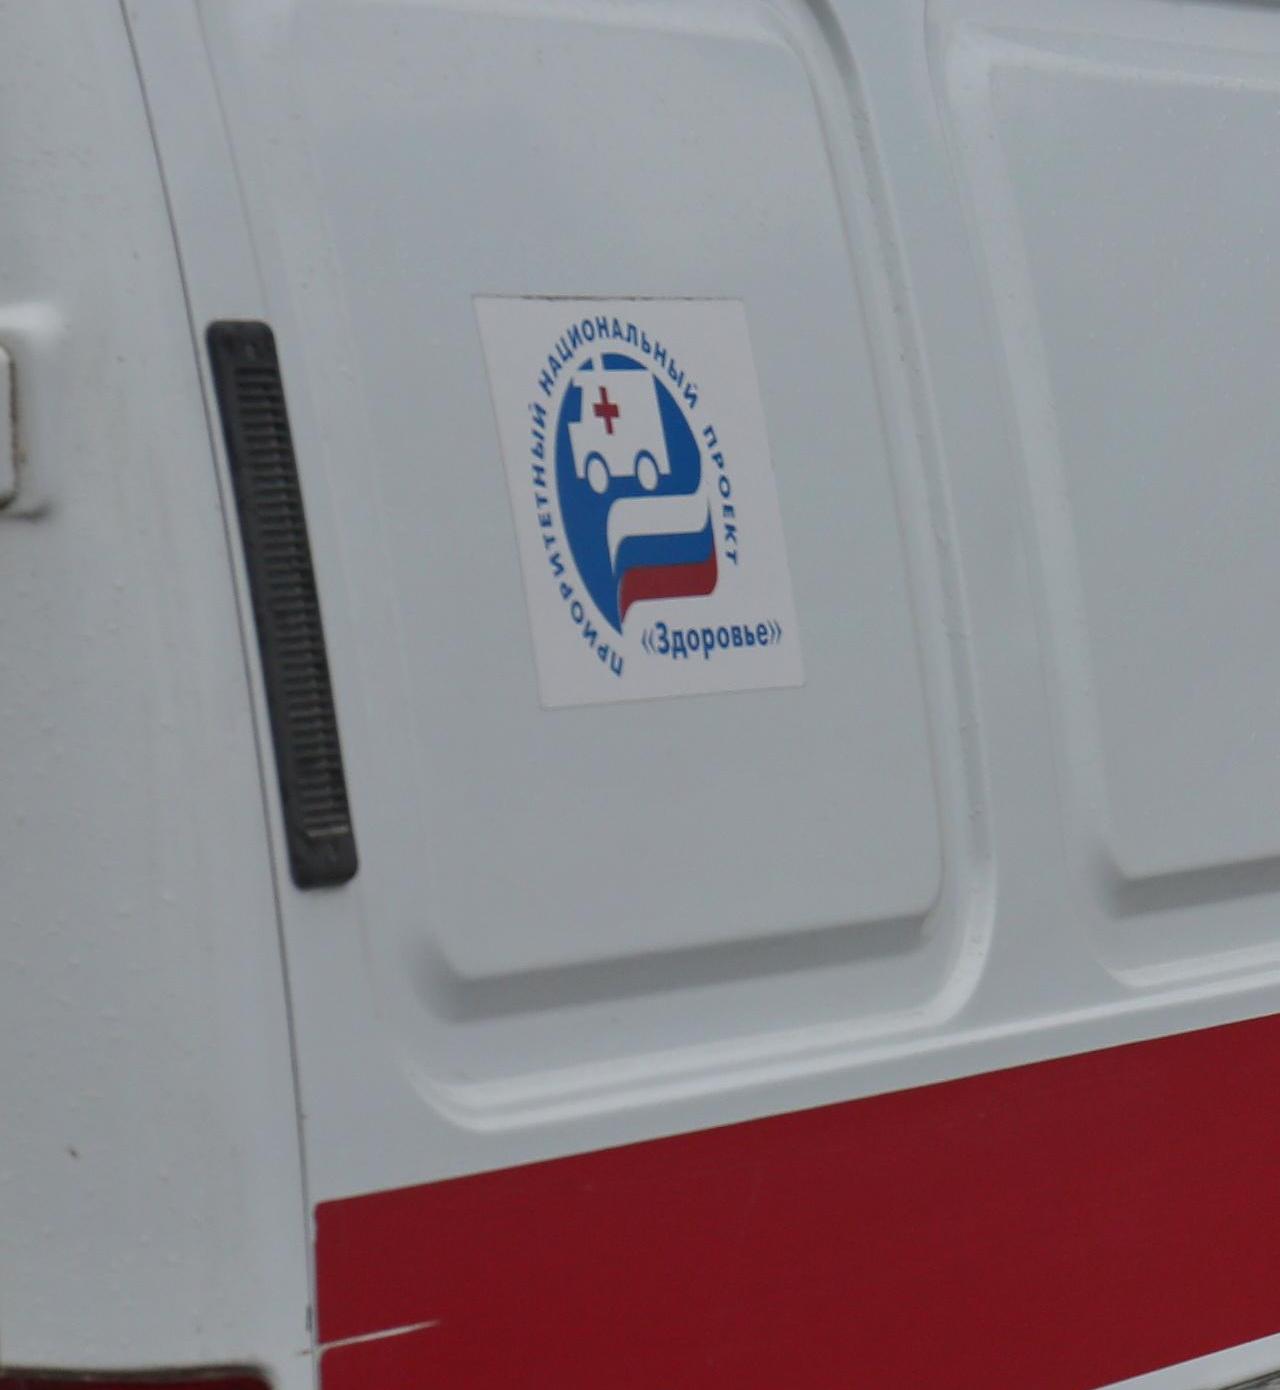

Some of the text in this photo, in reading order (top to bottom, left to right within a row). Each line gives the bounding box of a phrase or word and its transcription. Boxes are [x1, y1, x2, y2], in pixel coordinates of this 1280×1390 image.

[527, 315, 739, 678] ПРИОРИТЕТНЫЙ НАЦИОНАЛЬНЫЙ ПРОЕКТ
[640, 618, 783, 662] «Здоровье»
